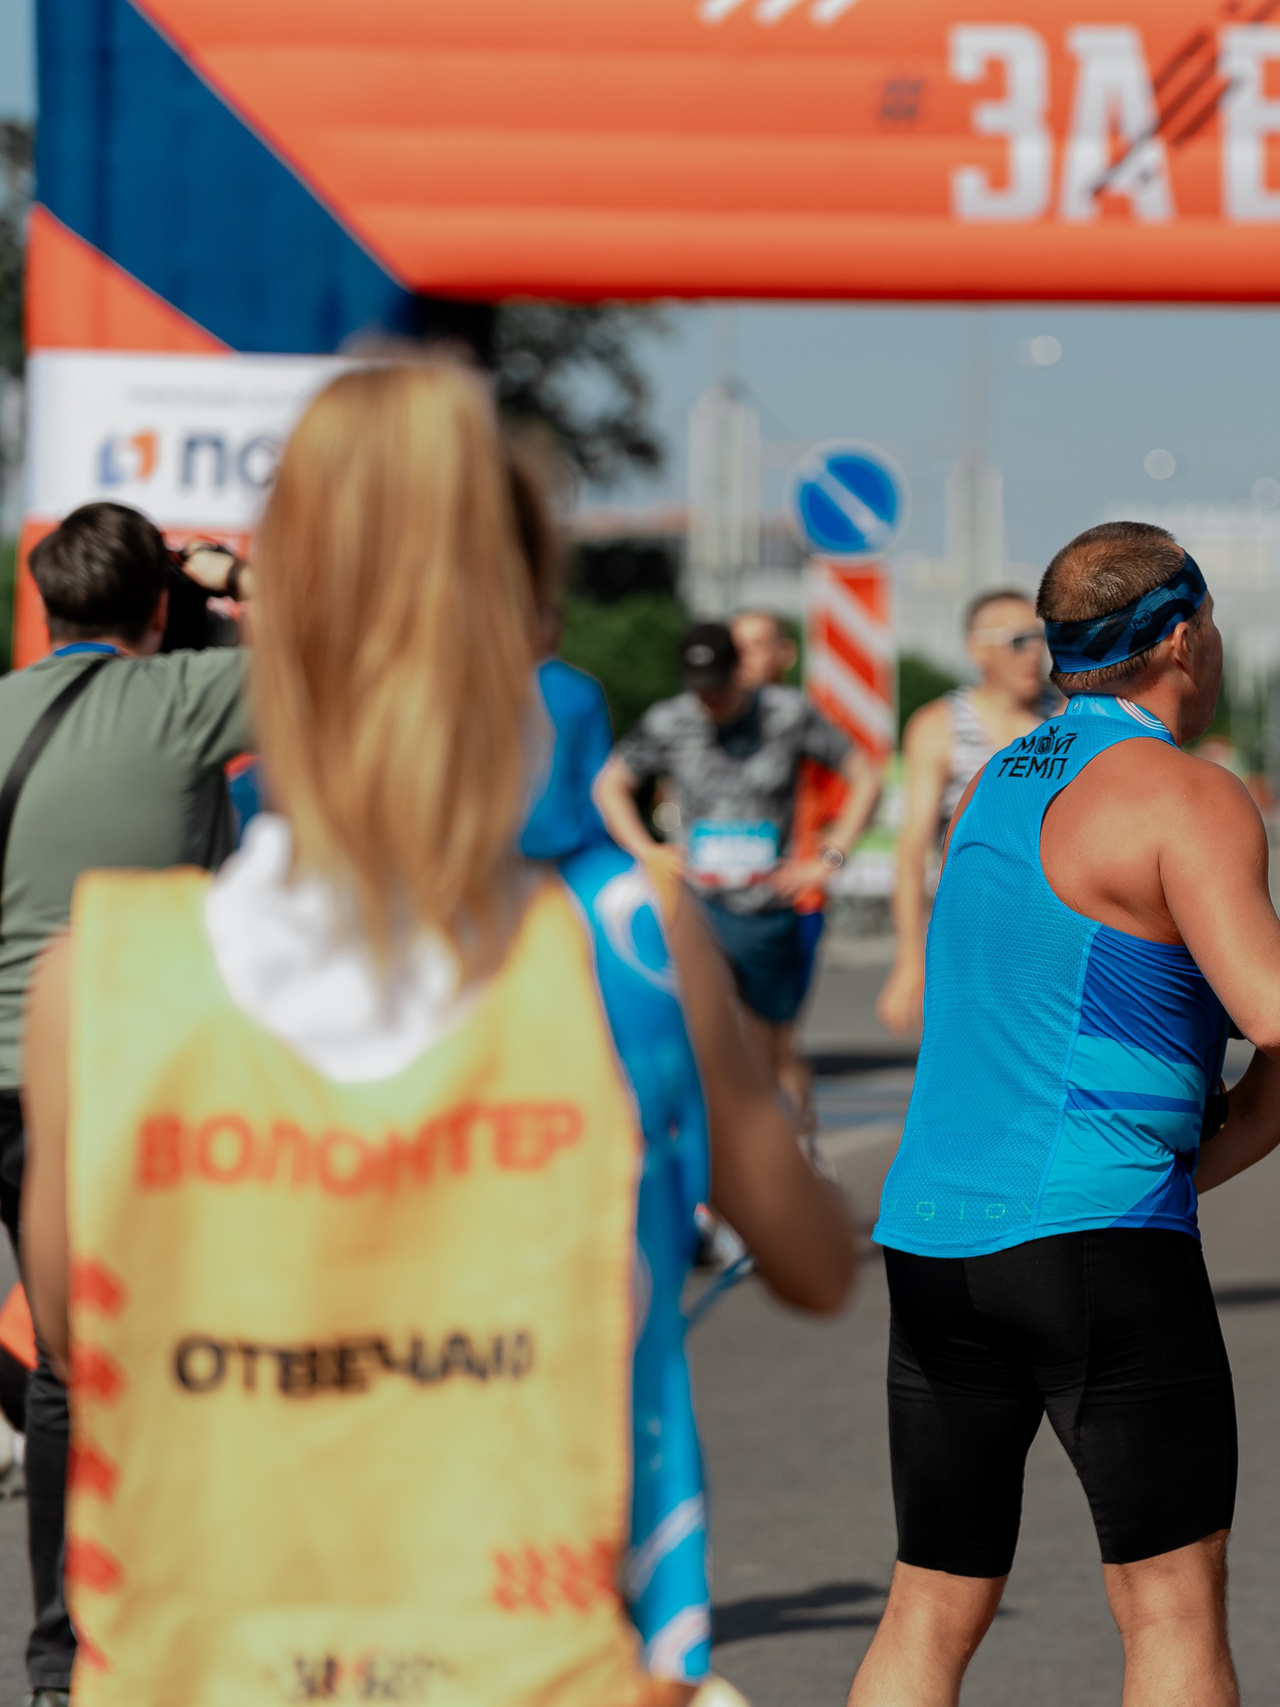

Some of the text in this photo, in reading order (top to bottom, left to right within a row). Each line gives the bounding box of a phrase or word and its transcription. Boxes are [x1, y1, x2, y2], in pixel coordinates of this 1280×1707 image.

[1011, 726, 1078, 756] МОЙ
[997, 756, 1069, 780] ТЕМП
[138, 1098, 586, 1198] ВОЛОНТЕР
